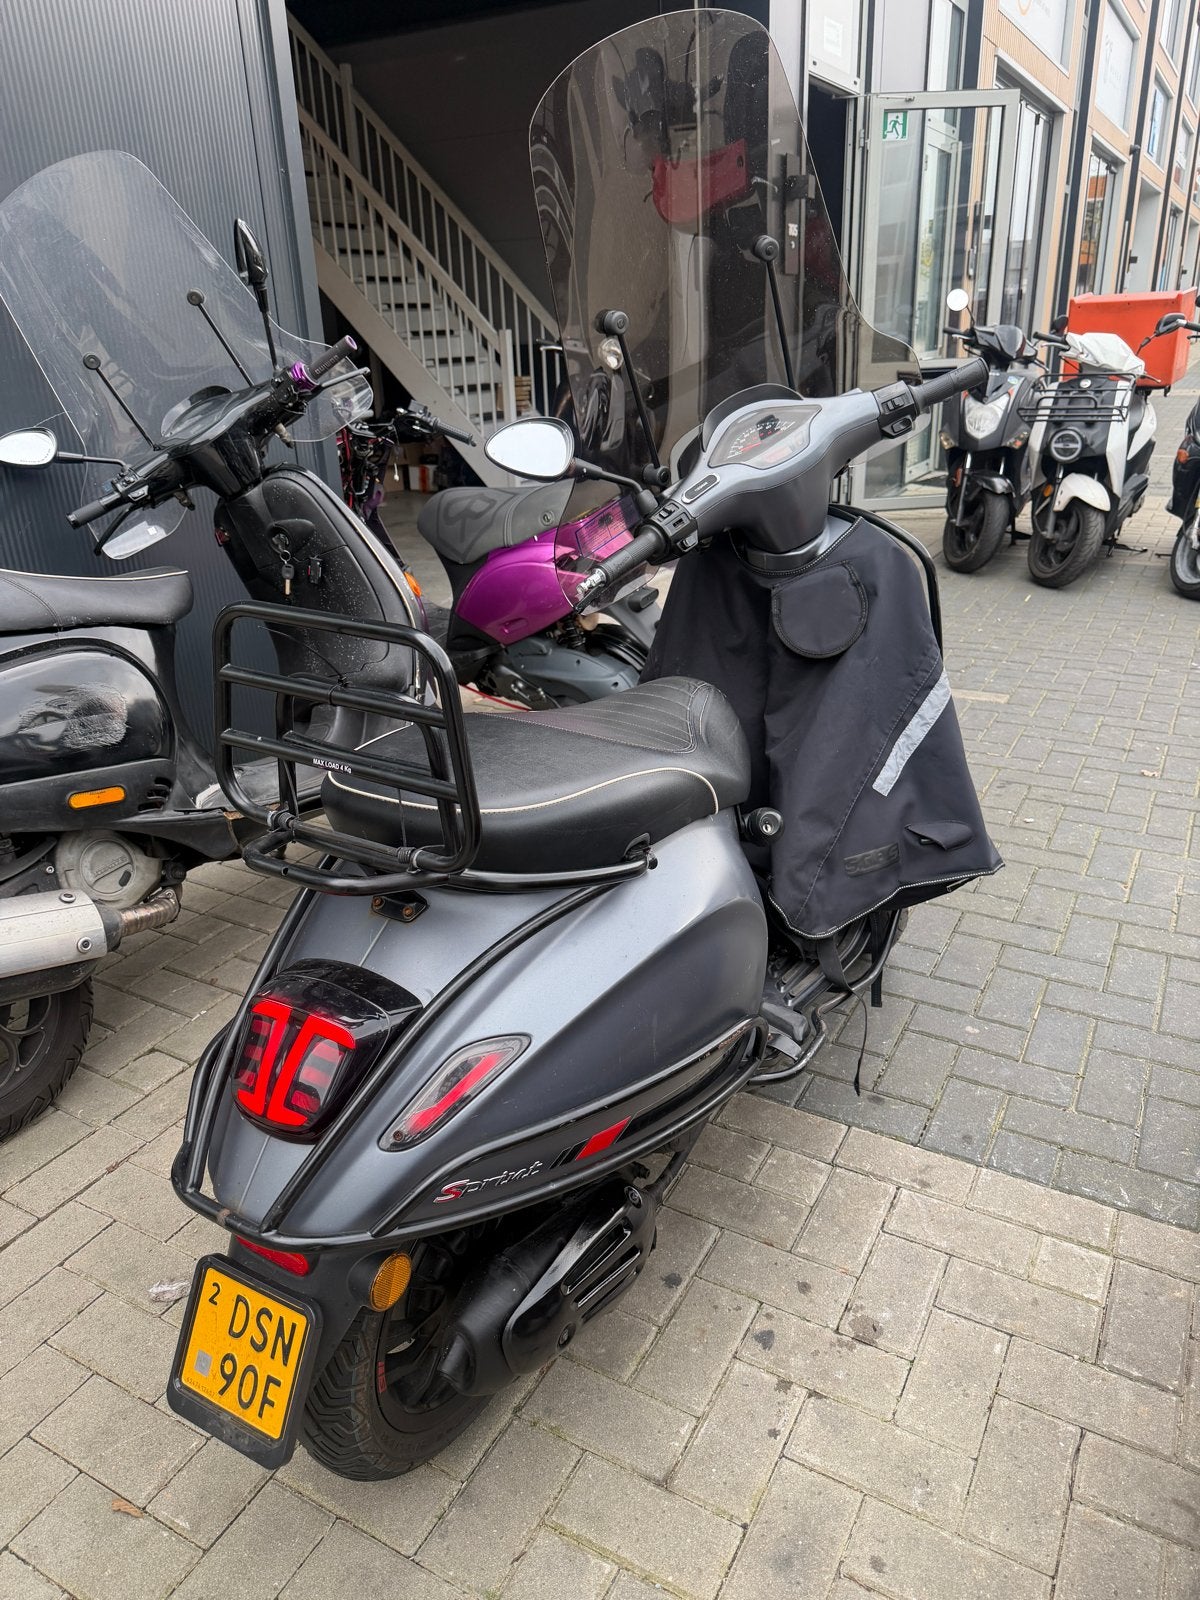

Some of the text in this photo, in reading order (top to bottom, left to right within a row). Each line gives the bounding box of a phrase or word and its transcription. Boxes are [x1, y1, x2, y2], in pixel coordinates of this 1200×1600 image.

[312, 758, 324, 766] MAX
[324, 760, 340, 770] LOAD
[433, 1160, 543, 1203] Sprint
[208, 1282, 297, 1367] 2 DSN
[218, 1352, 282, 1419] 90F
